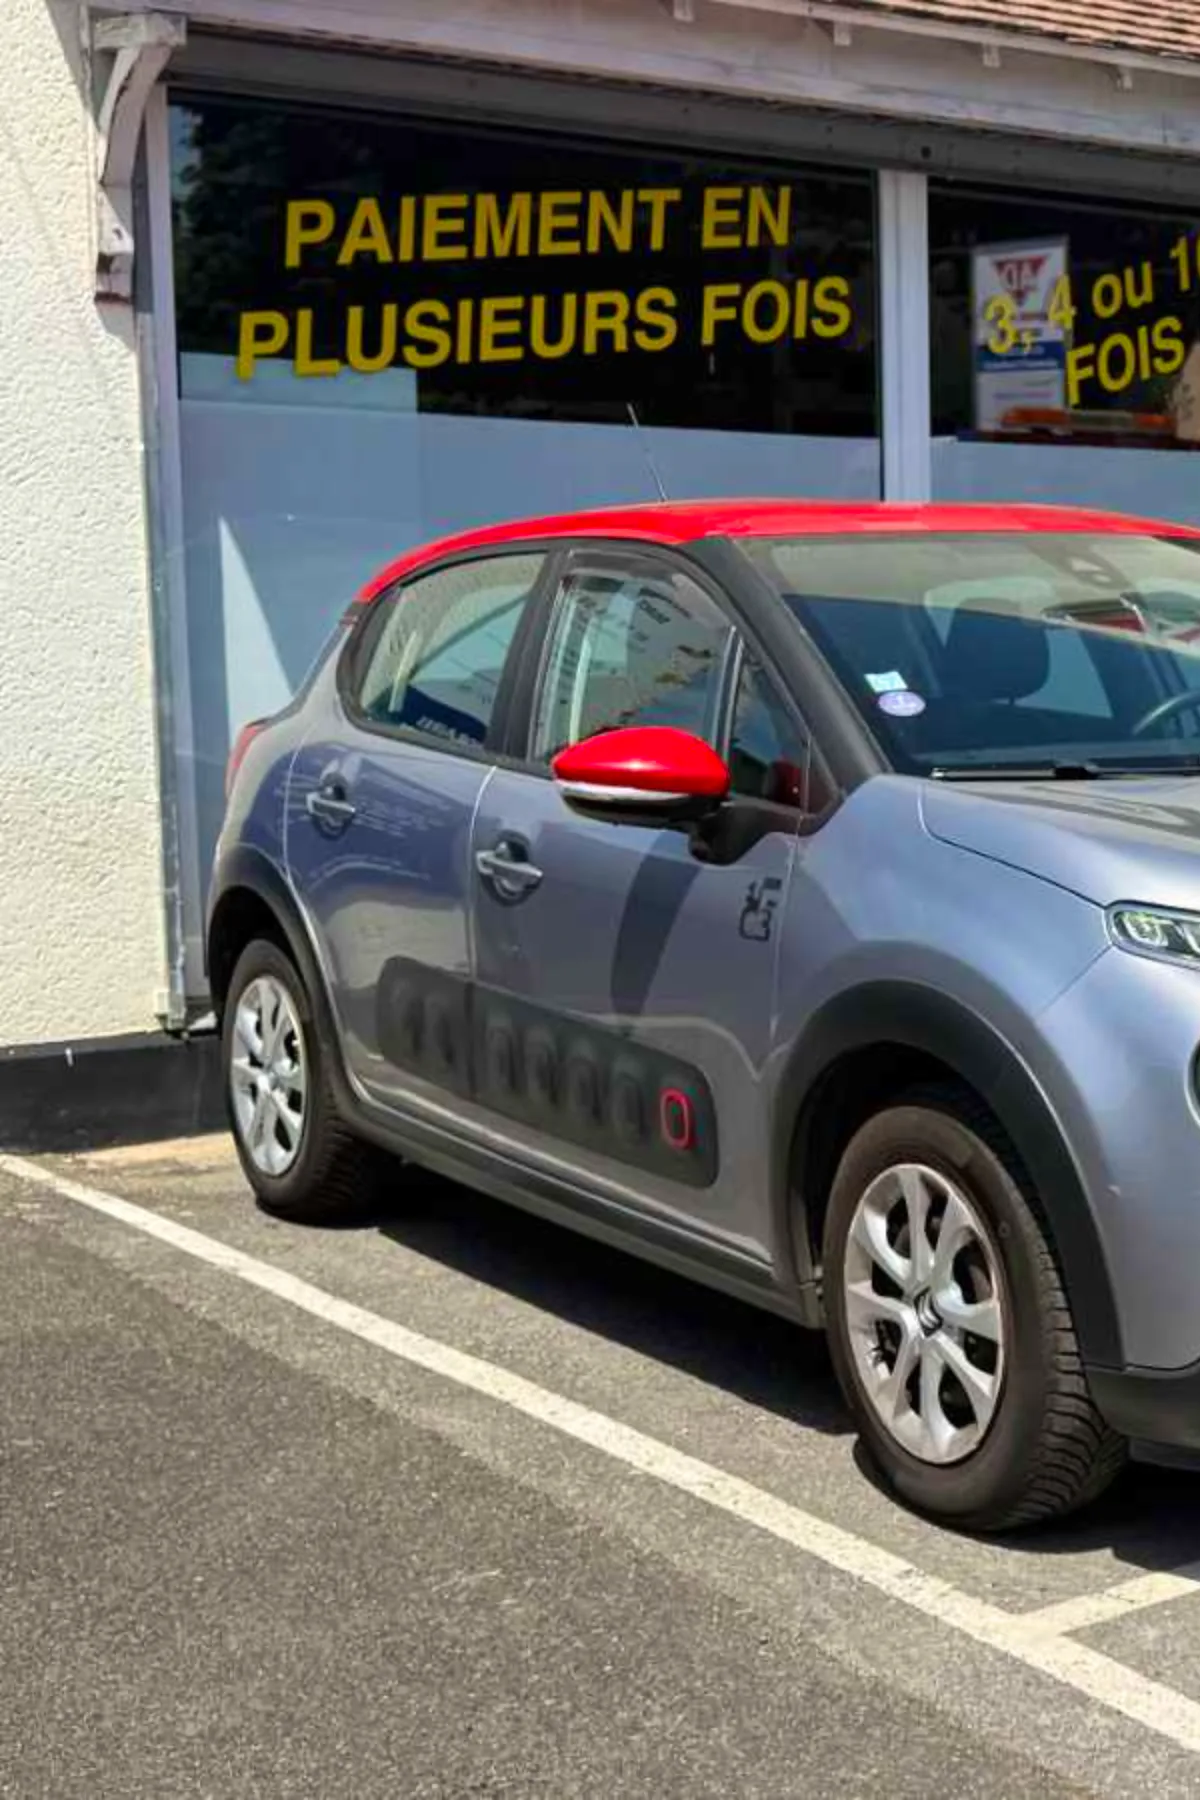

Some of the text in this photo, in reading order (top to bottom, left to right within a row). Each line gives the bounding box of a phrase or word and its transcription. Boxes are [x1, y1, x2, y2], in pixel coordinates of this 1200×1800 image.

[284, 186, 792, 268] PAIEMENT EN
[235, 275, 852, 382] PLUSIEURS FOIS
[1049, 273, 1078, 330] 4
[1092, 261, 1154, 319] ou
[1066, 315, 1186, 407] FOIS
